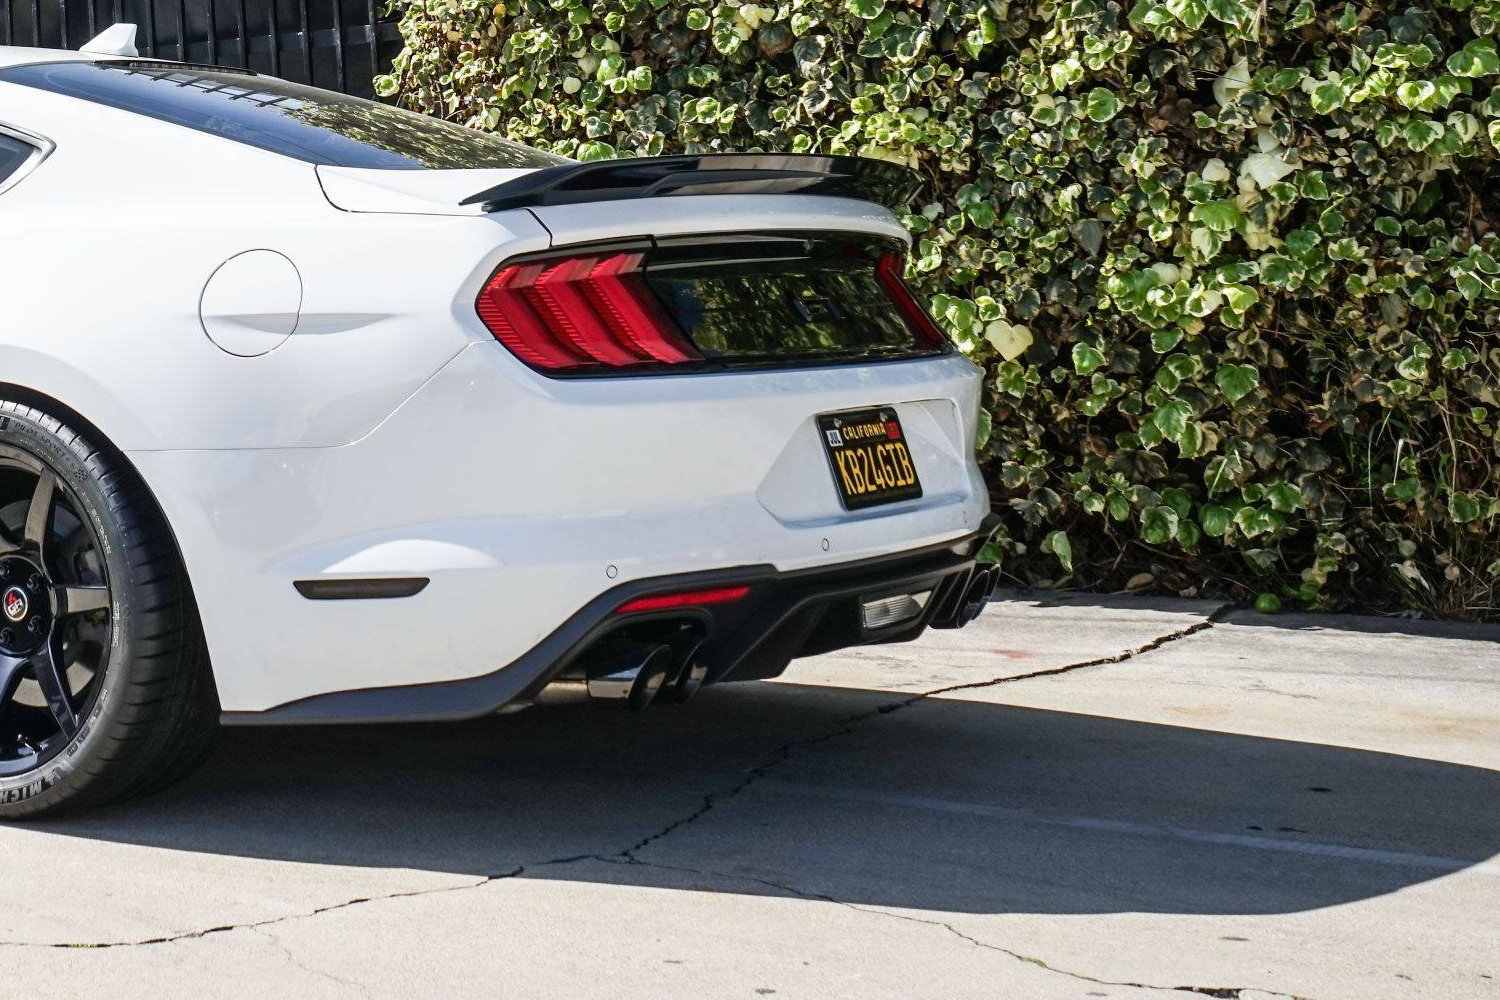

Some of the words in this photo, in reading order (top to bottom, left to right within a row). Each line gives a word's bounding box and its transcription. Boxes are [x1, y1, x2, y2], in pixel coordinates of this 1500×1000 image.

[14, 422, 38, 436] PILOT
[41, 435, 66, 457] SPORT
[843, 423, 887, 440] CALIFORNIA
[835, 442, 915, 495] KB24GIB
